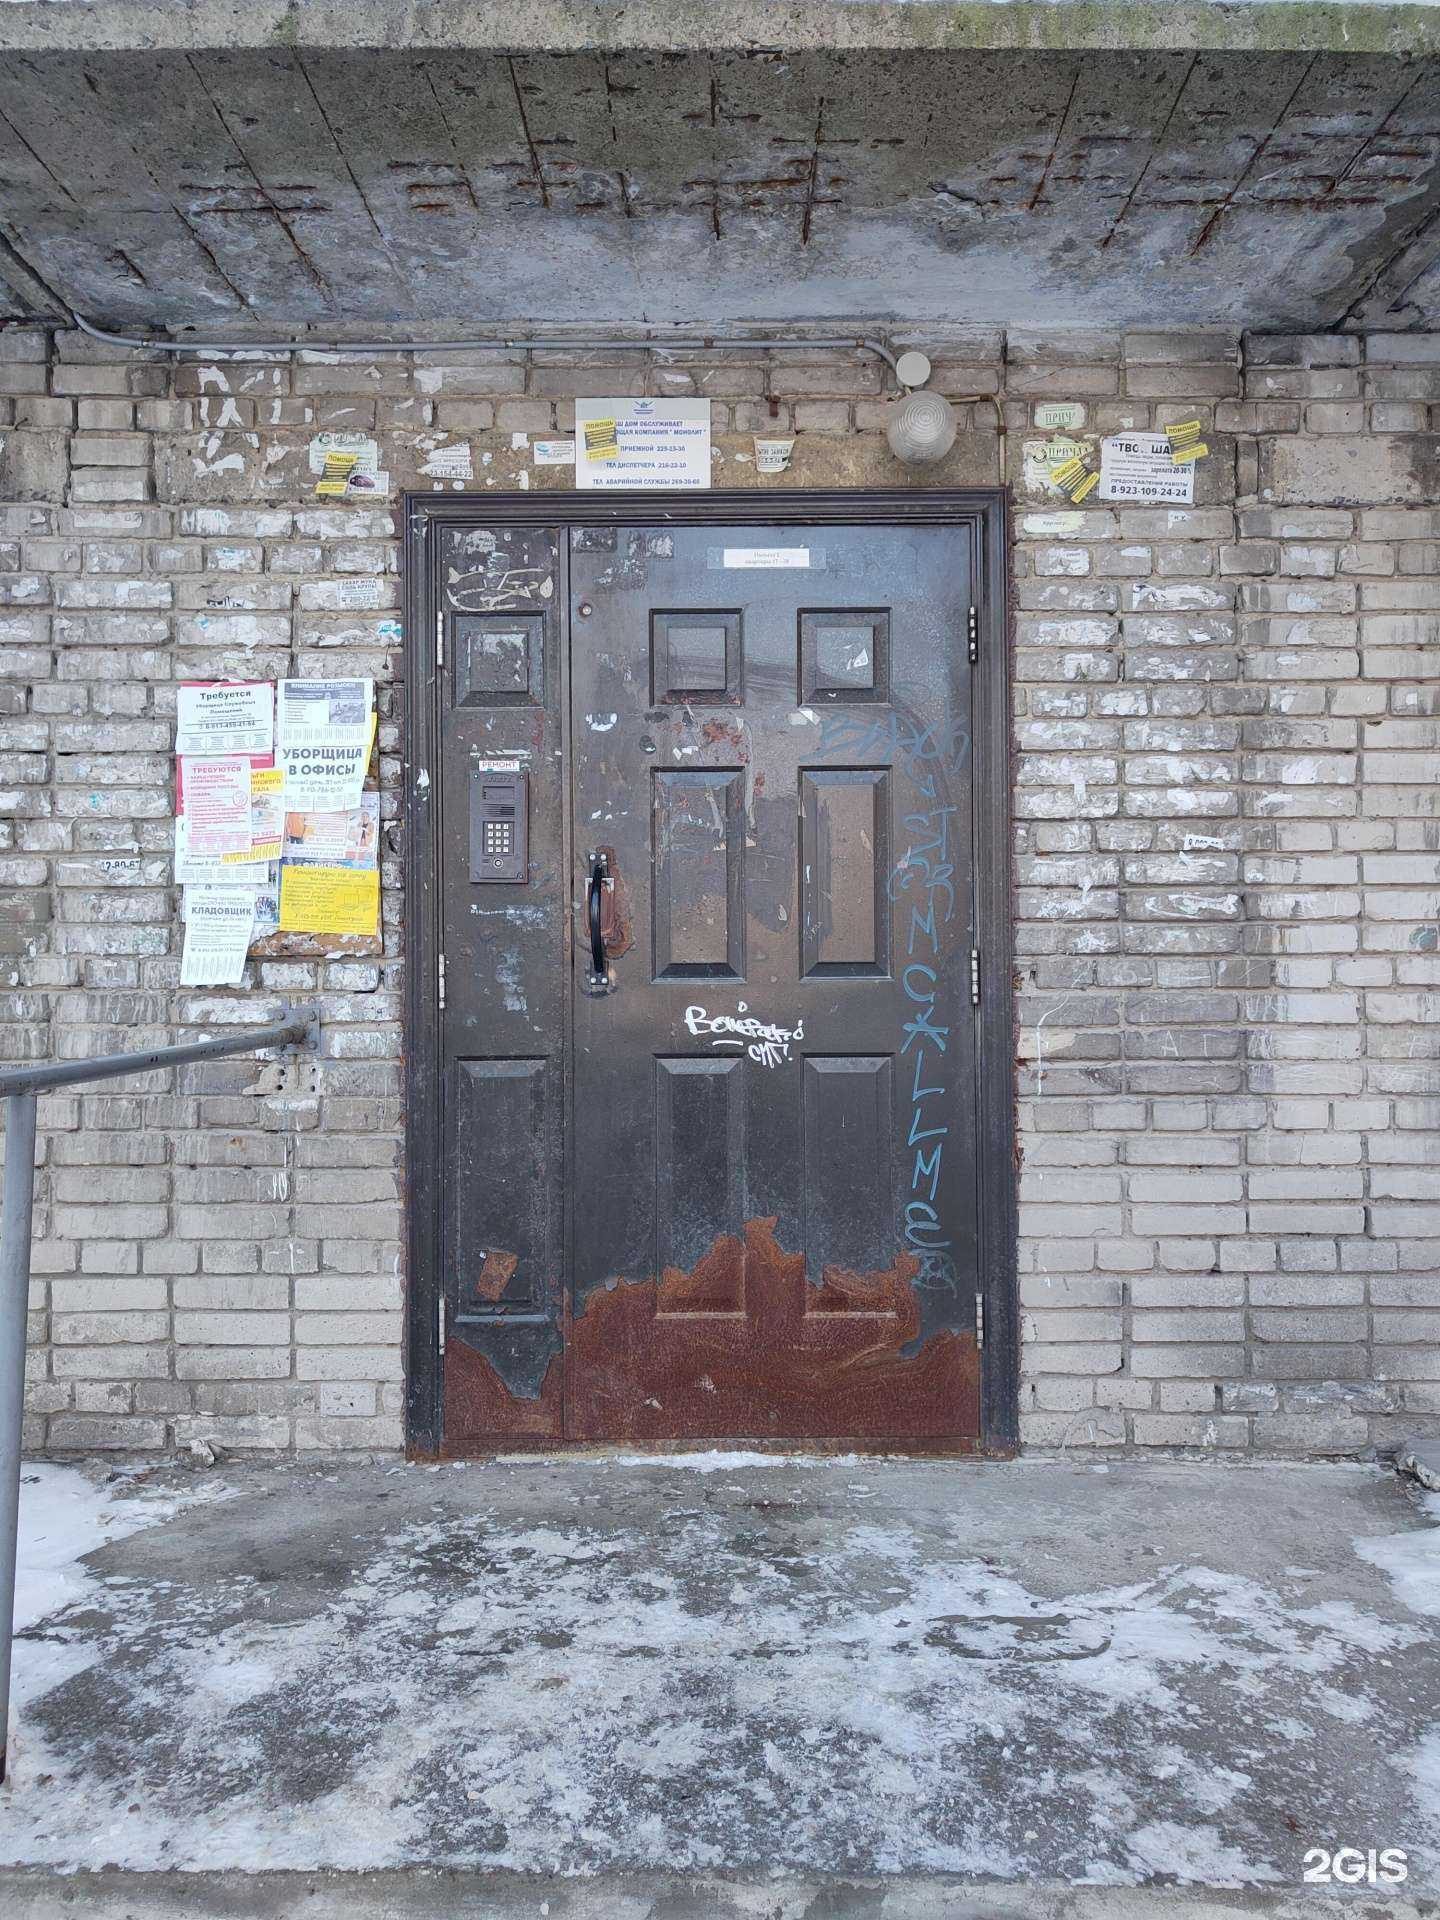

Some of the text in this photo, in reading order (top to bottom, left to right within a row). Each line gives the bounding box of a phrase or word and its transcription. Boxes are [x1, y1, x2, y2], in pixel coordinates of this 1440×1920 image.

[1111, 486, 1187, 497] 8-923-109-24-24
[283, 748, 362, 761] УБОРЩИЦА
[288, 764, 356, 775] В ОФИСЫ
[191, 907, 252, 915] КЛАДОВЩИК
